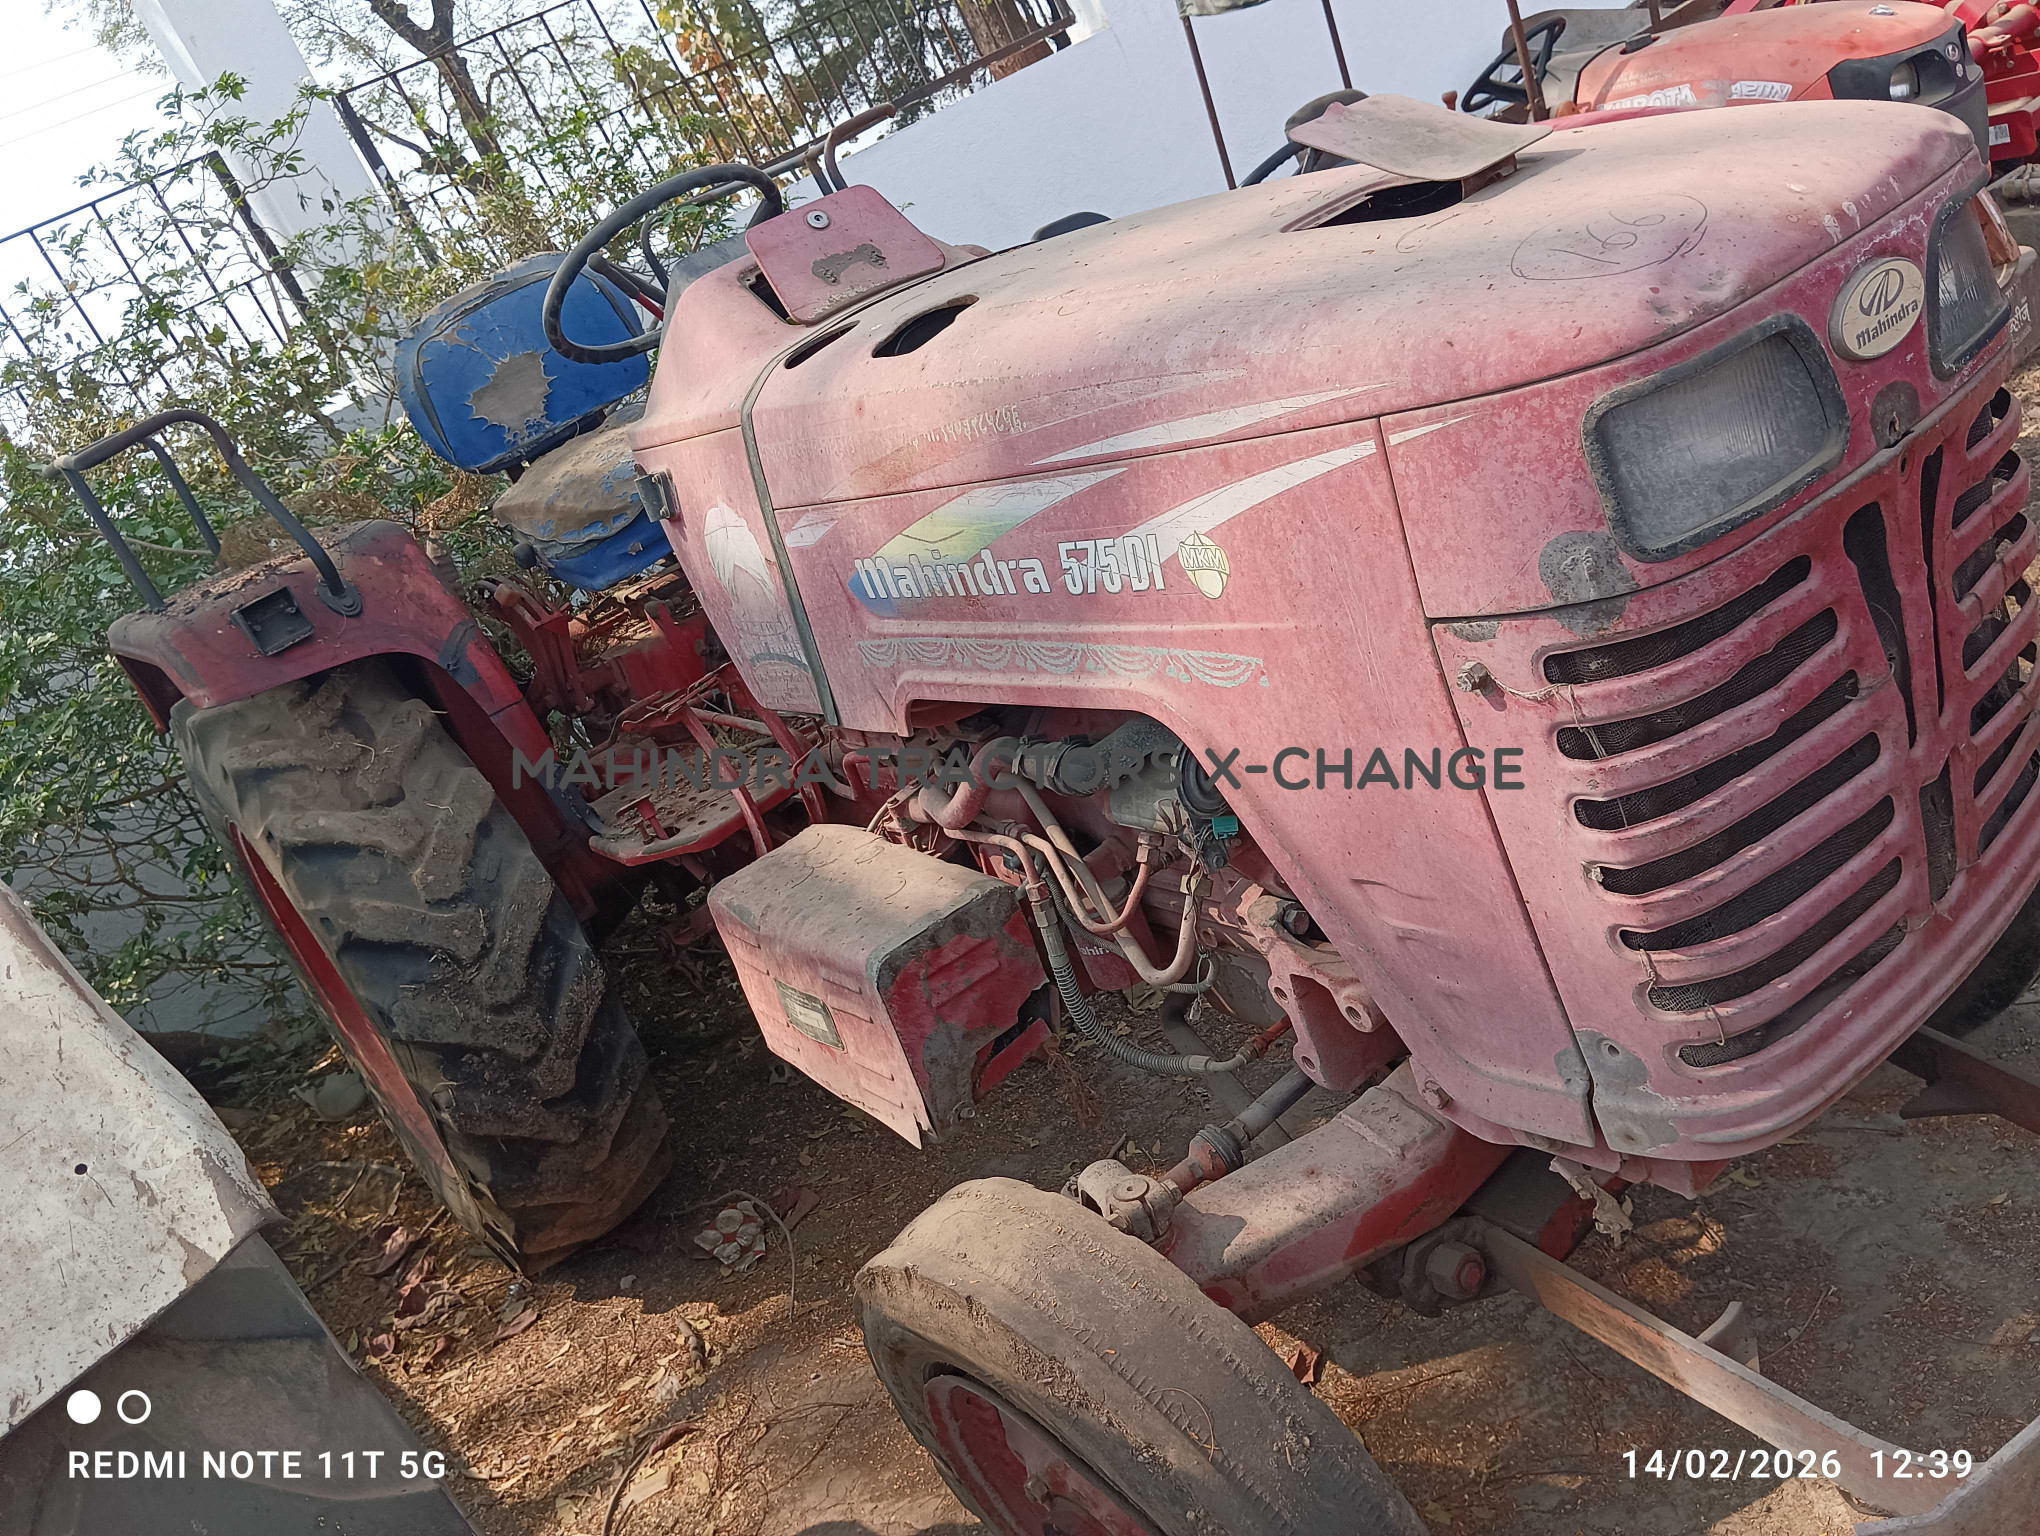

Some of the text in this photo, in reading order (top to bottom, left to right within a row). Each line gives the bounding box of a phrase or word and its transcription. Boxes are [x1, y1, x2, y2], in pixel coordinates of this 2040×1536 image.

[1855, 299, 1919, 350] Mahindra
[854, 548, 1051, 600] Mahindra
[1179, 547, 1229, 573] MKM
